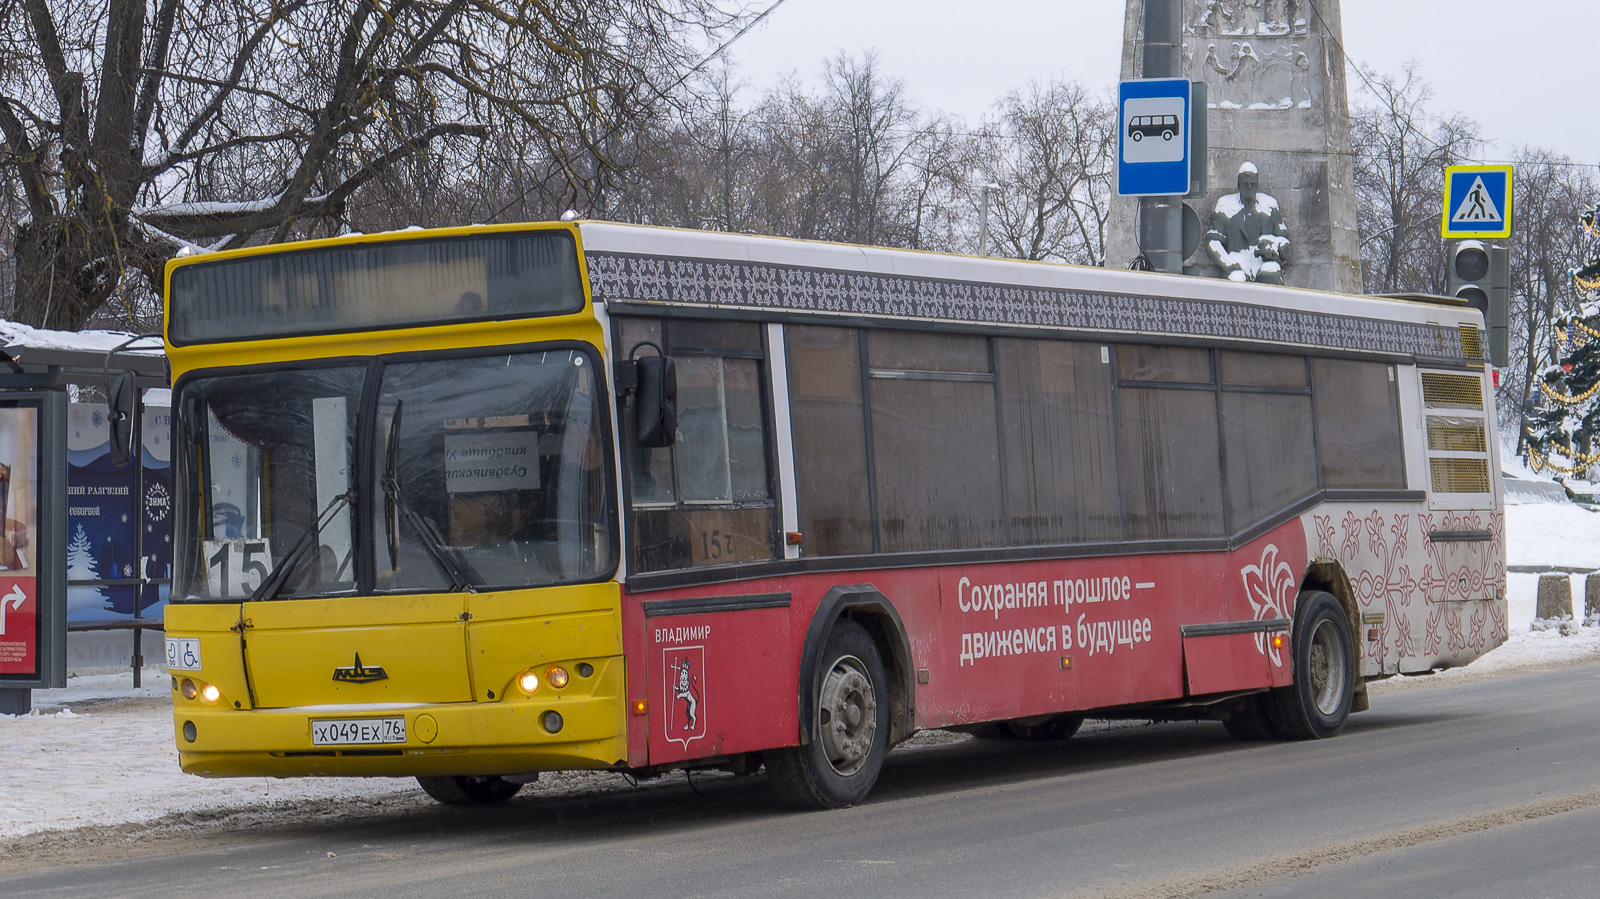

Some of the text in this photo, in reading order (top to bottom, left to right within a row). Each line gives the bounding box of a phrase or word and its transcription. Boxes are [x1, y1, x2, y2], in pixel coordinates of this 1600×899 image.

[461, 447, 526, 459] кладбище
[210, 543, 268, 597] 15
[958, 576, 1048, 620] Сохраняя
[1053, 575, 1131, 614] прошлое
[655, 625, 711, 644] ВЛАДИМИР
[960, 612, 1152, 667] движемся в будущее
[385, 721, 401, 735] 76
